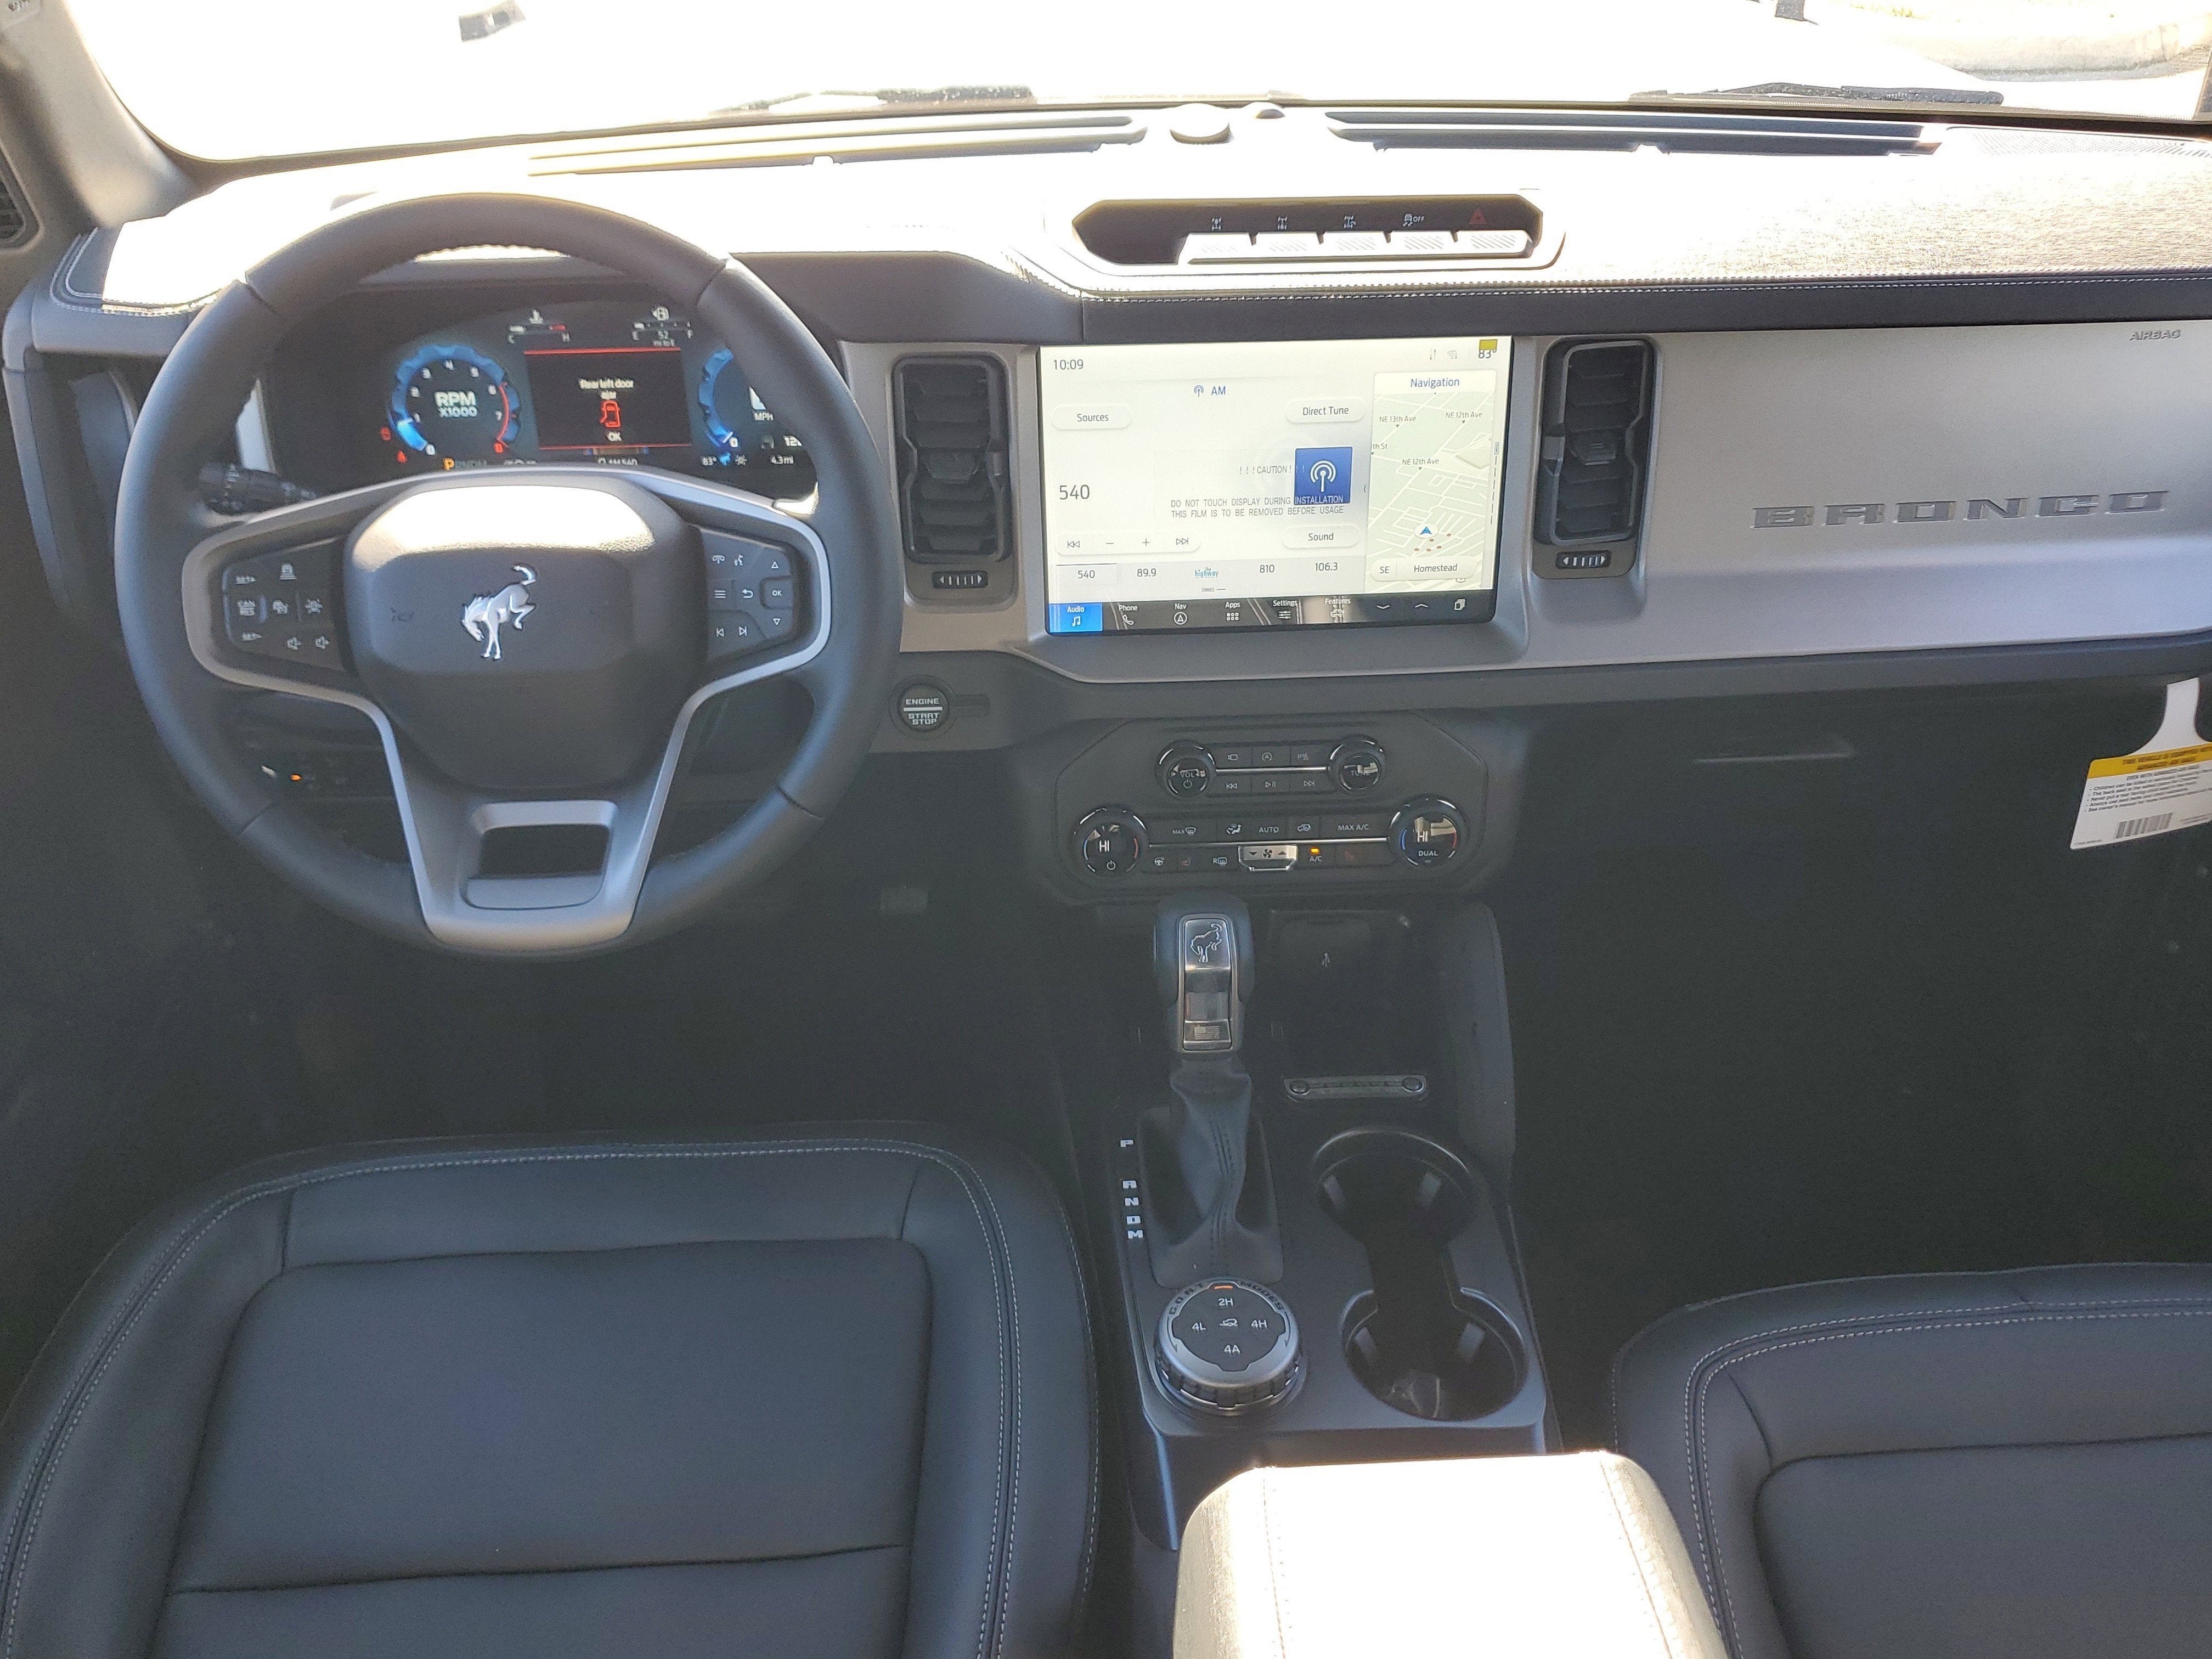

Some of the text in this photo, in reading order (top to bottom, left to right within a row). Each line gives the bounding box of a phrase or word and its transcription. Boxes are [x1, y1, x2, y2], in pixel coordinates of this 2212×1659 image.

[2129, 329, 2181, 341] AIRBAG
[1053, 359, 1084, 370] 10:09
[615, 378, 634, 388] door
[1410, 378, 1459, 388] Navigation
[1211, 386, 1226, 396] AM
[435, 391, 476, 407] RPM
[753, 412, 774, 421] MPH
[1302, 407, 1349, 416] Direct Tune
[1077, 413, 1109, 422] Sources
[608, 432, 622, 441] OK
[443, 458, 455, 470] P
[1059, 484, 1090, 501] 540
[1171, 495, 1343, 508] DO NOT TOUCH DISPLAY DURING INSTALLATION
[1171, 506, 1344, 518] THIS FILM IS TO BE REMOVED BEFORE USAGE
[1751, 490, 2169, 528] BRONCO
[1308, 532, 1334, 541] Sound
[1260, 565, 1275, 573] 810
[1315, 562, 1338, 572] 106.3
[1379, 566, 1390, 574] SE
[1414, 563, 1458, 573] Homestead
[1077, 570, 1095, 579] 540
[1137, 568, 1156, 578] 89.9
[1273, 599, 1297, 607] Settings
[1417, 830, 1428, 843] HI
[1099, 839, 1110, 853] HI
[1120, 1139, 1134, 1148] P
[1125, 1197, 1139, 1206] N
[1126, 1215, 1141, 1225] D
[1128, 1229, 1143, 1239] M
[1240, 1281, 1285, 1311] MODES
[1218, 1297, 1233, 1307] 2H
[1192, 1322, 1206, 1332] 4L
[1251, 1319, 1268, 1330] 4H
[1224, 1344, 1240, 1355] 4A
